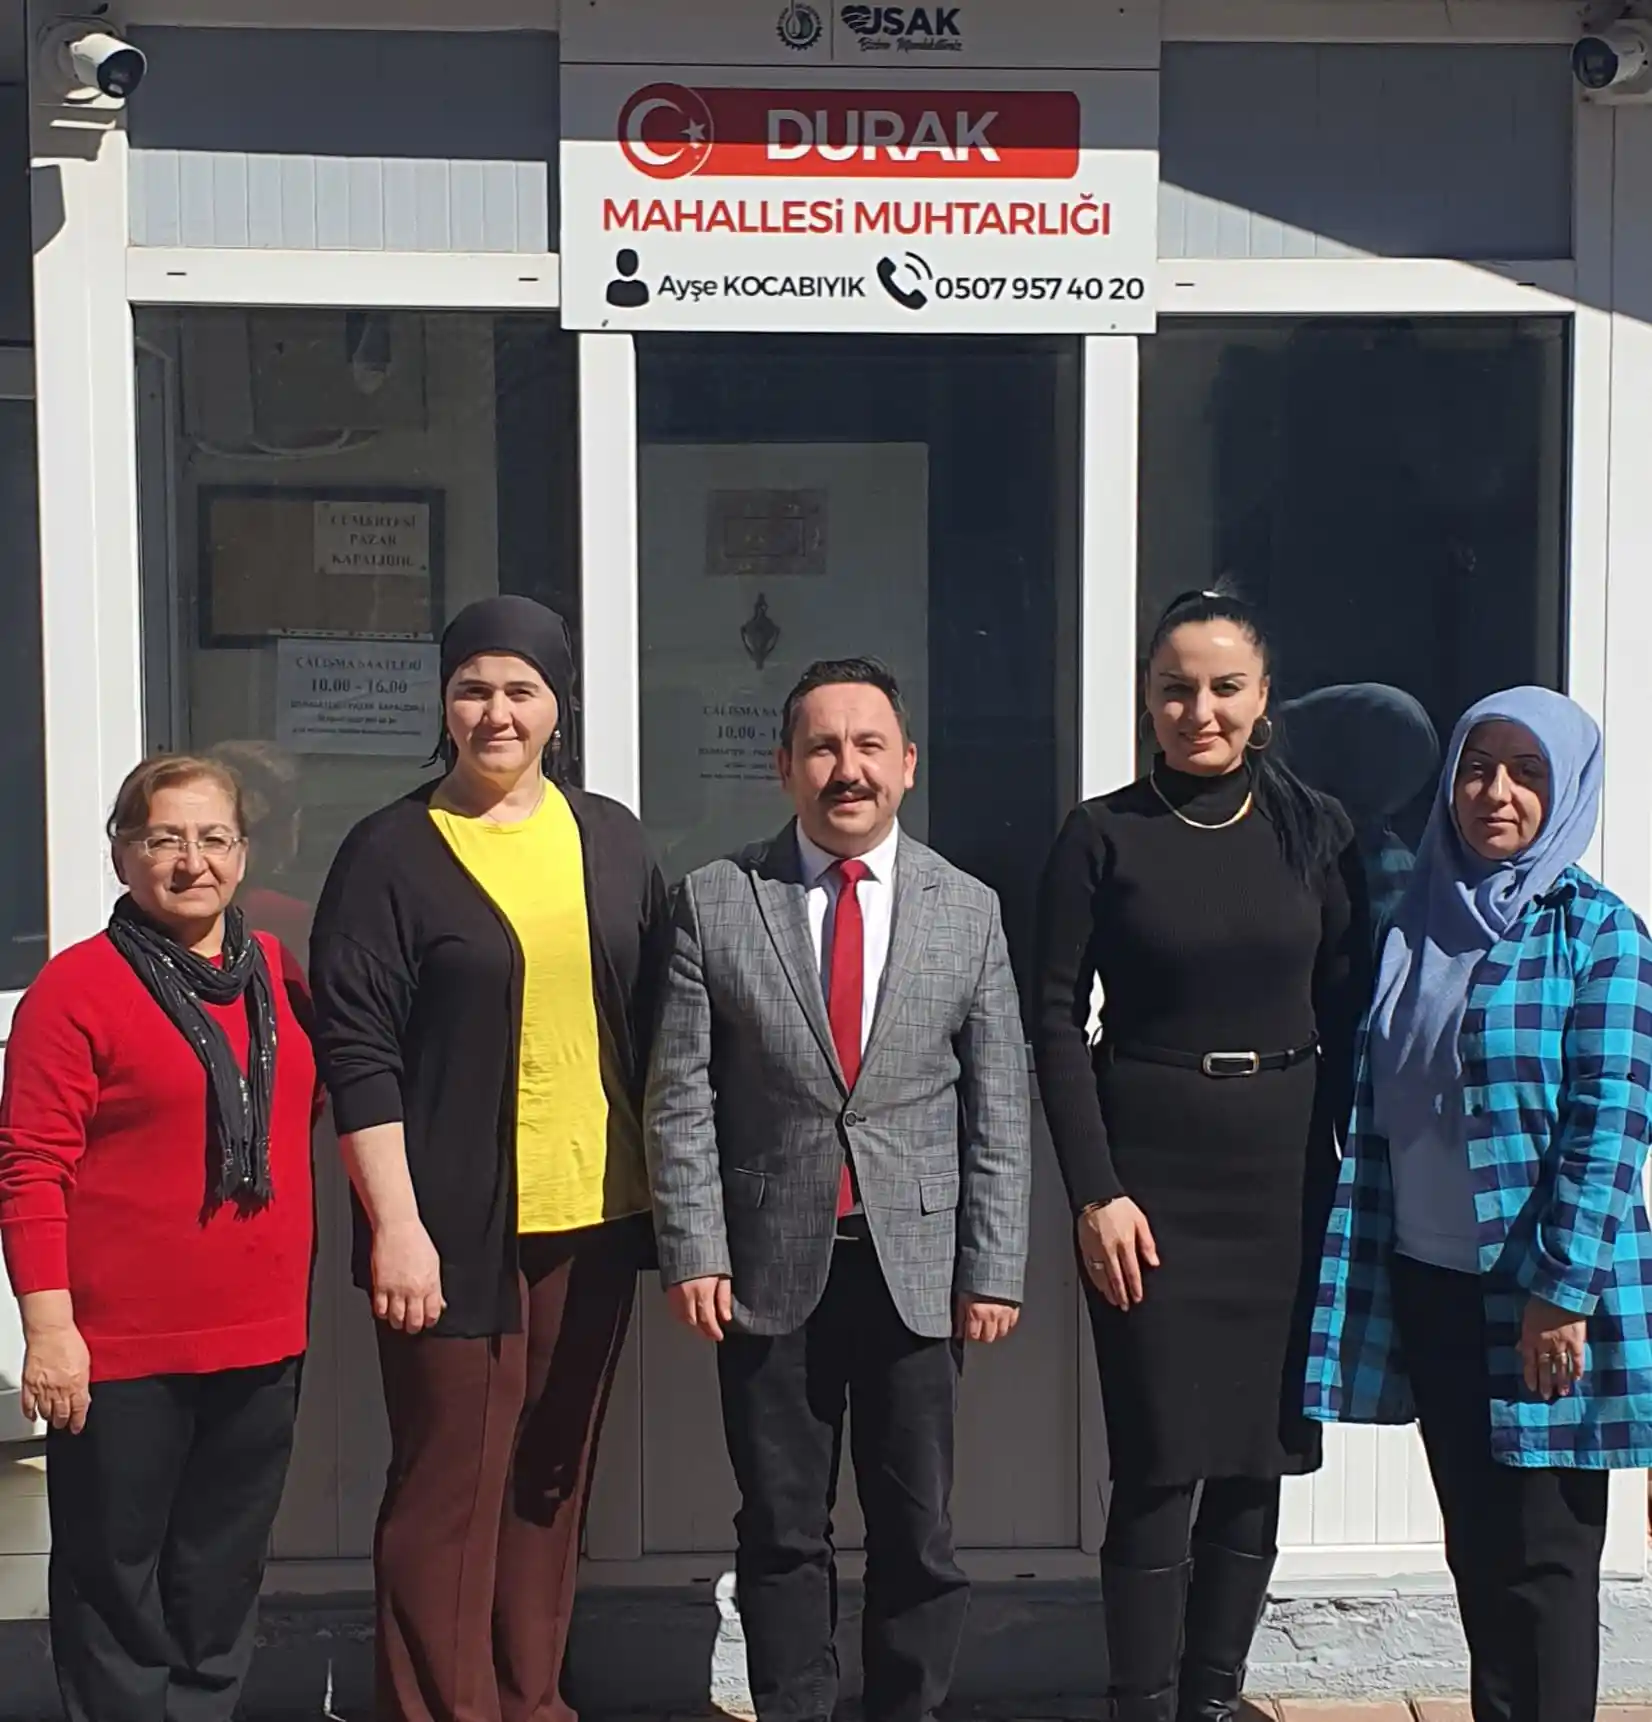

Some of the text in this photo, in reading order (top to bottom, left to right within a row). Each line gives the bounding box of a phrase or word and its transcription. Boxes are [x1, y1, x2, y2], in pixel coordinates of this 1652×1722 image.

[767, 109, 1001, 161] DURAK
[854, 193, 1110, 235] MUHTARLIĞI
[657, 275, 866, 302] Ayşe KOCABIYIK
[935, 277, 1145, 300] 0507 957 40 20
[311, 678, 351, 692] 10.00
[716, 725, 756, 740] 10.00
